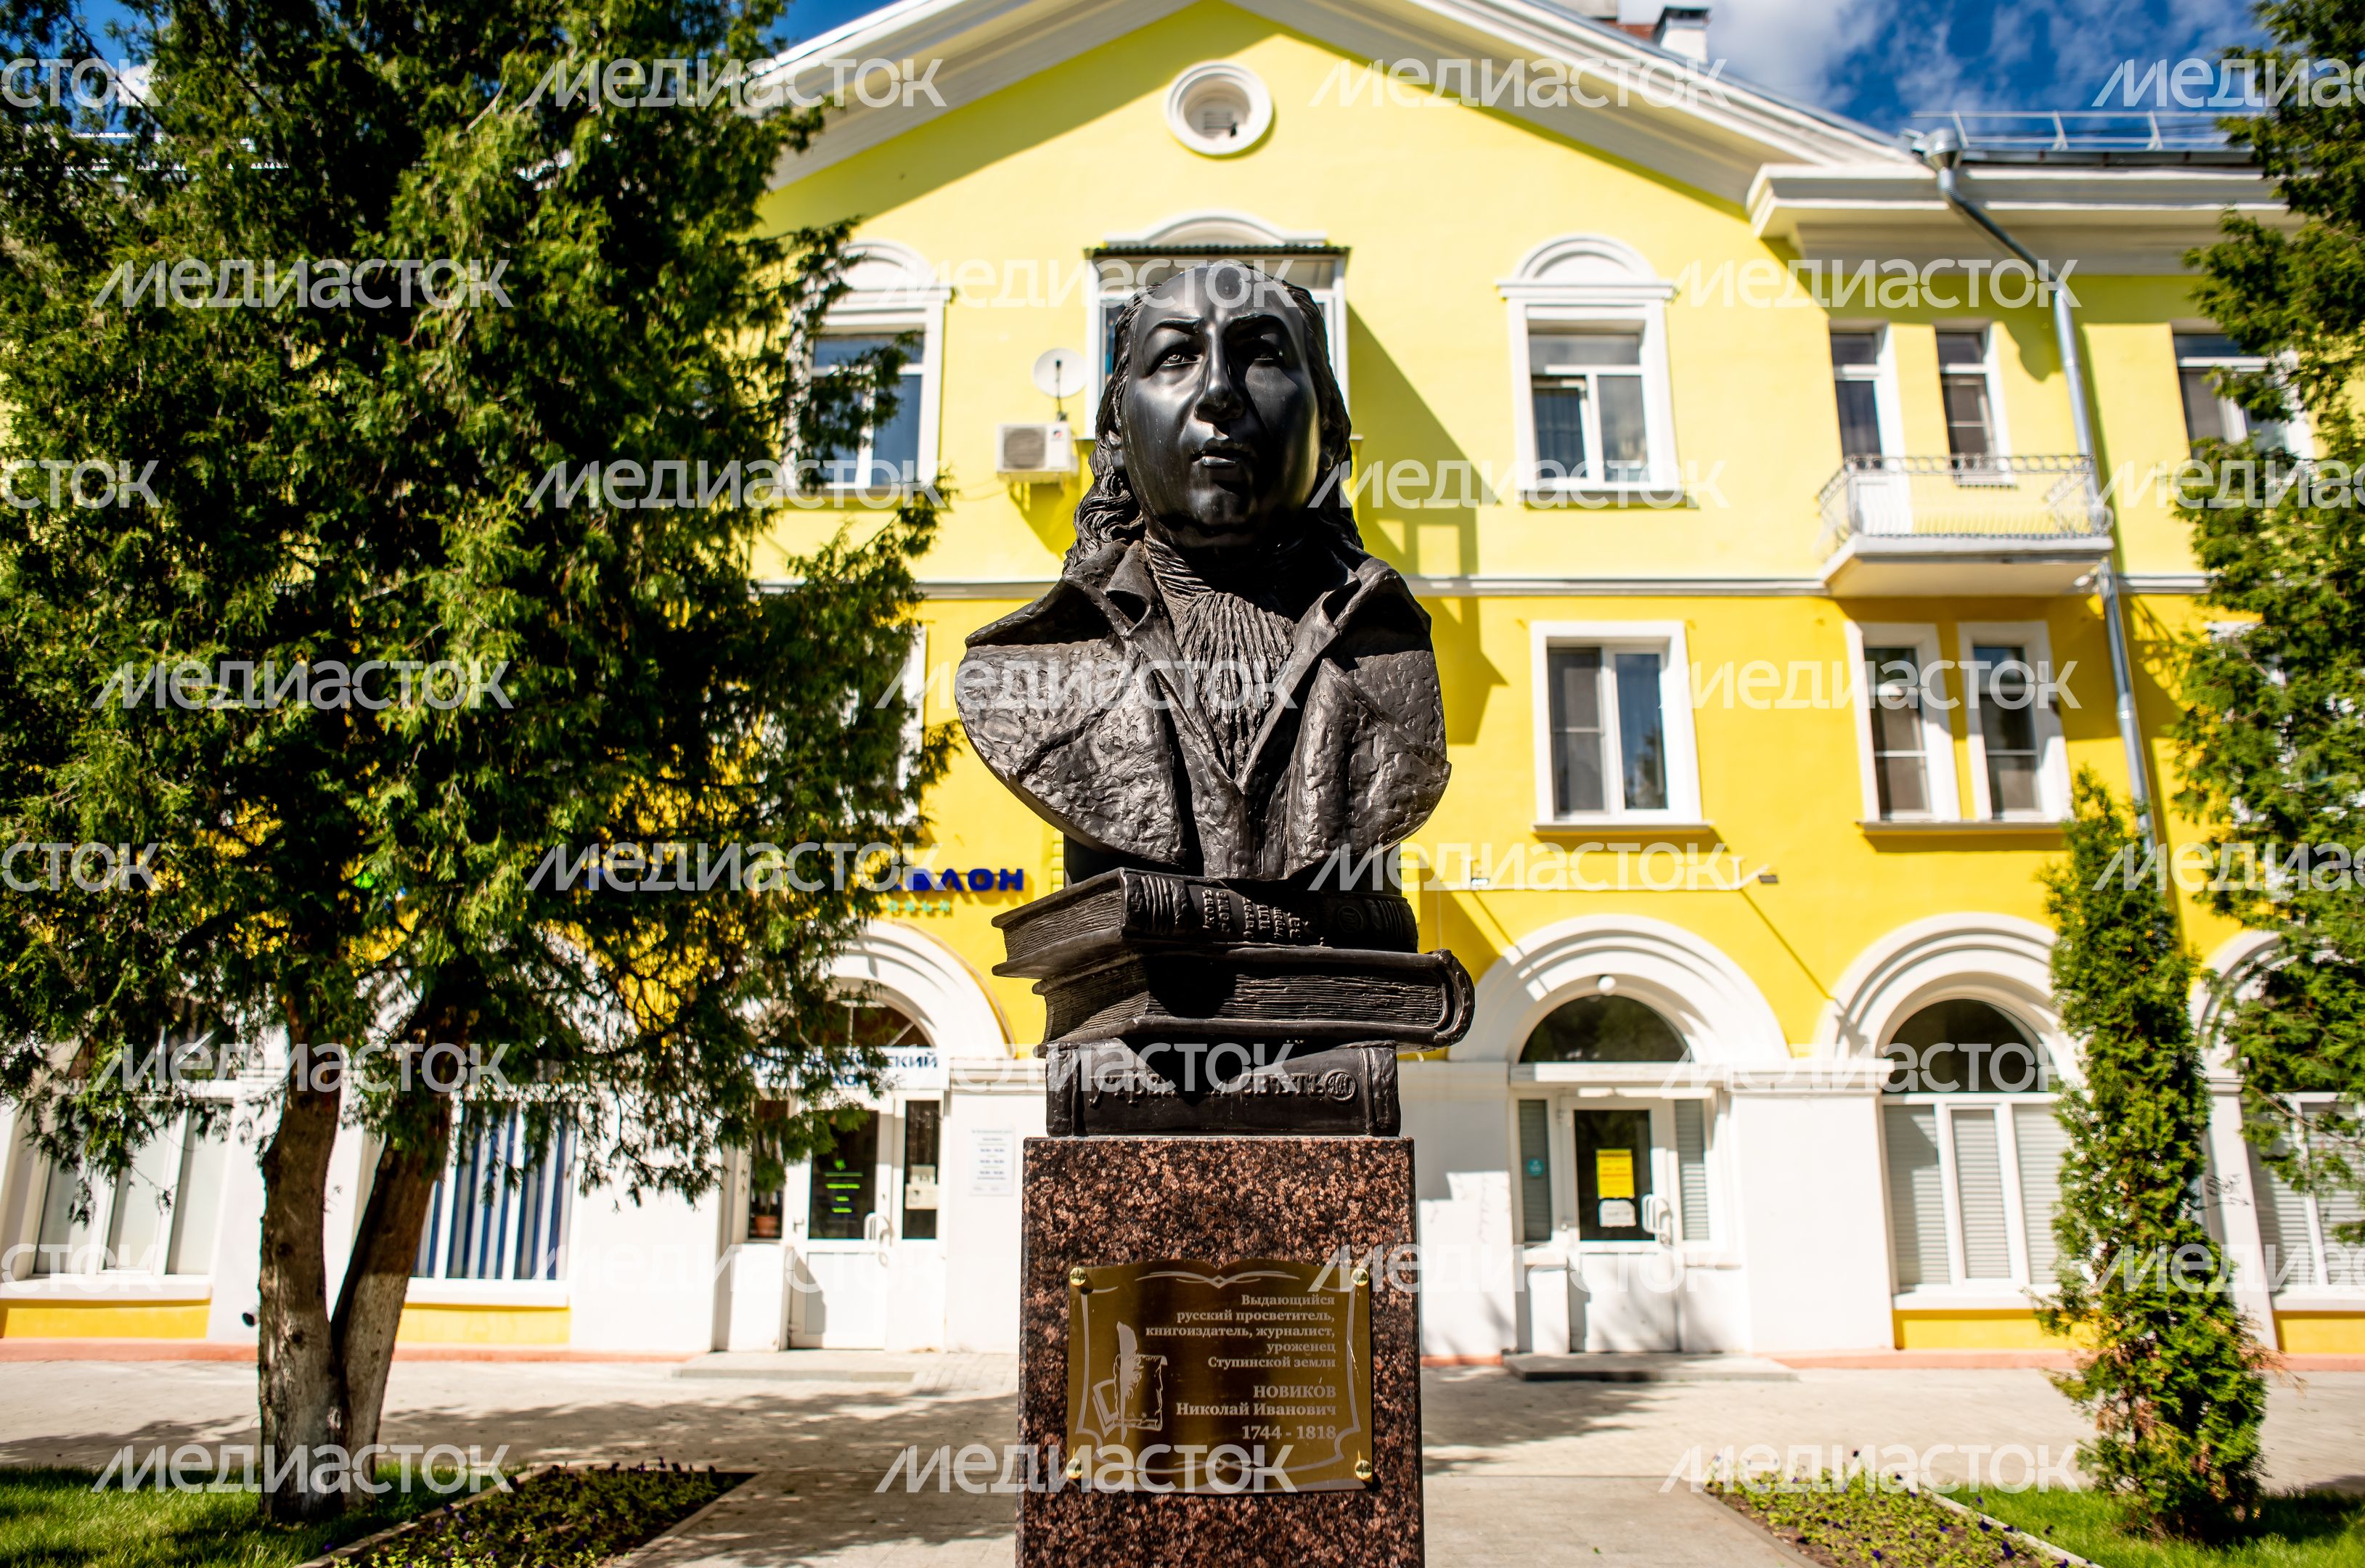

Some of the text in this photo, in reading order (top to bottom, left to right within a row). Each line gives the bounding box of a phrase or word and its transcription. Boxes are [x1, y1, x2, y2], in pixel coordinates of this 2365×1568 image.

[1241, 1294, 1335, 1307] Выдающийся
[1176, 1309, 1335, 1324] русский просветитель,
[1145, 1326, 1335, 1340] книгоиздатель, журналист,
[1267, 1343, 1336, 1355] уроженец
[1207, 1355, 1336, 1371] Ступинской земли
[1176, 1402, 1337, 1416] Николай Иванович
[1241, 1424, 1283, 1440] 1744
[1296, 1424, 1336, 1440] 1818
